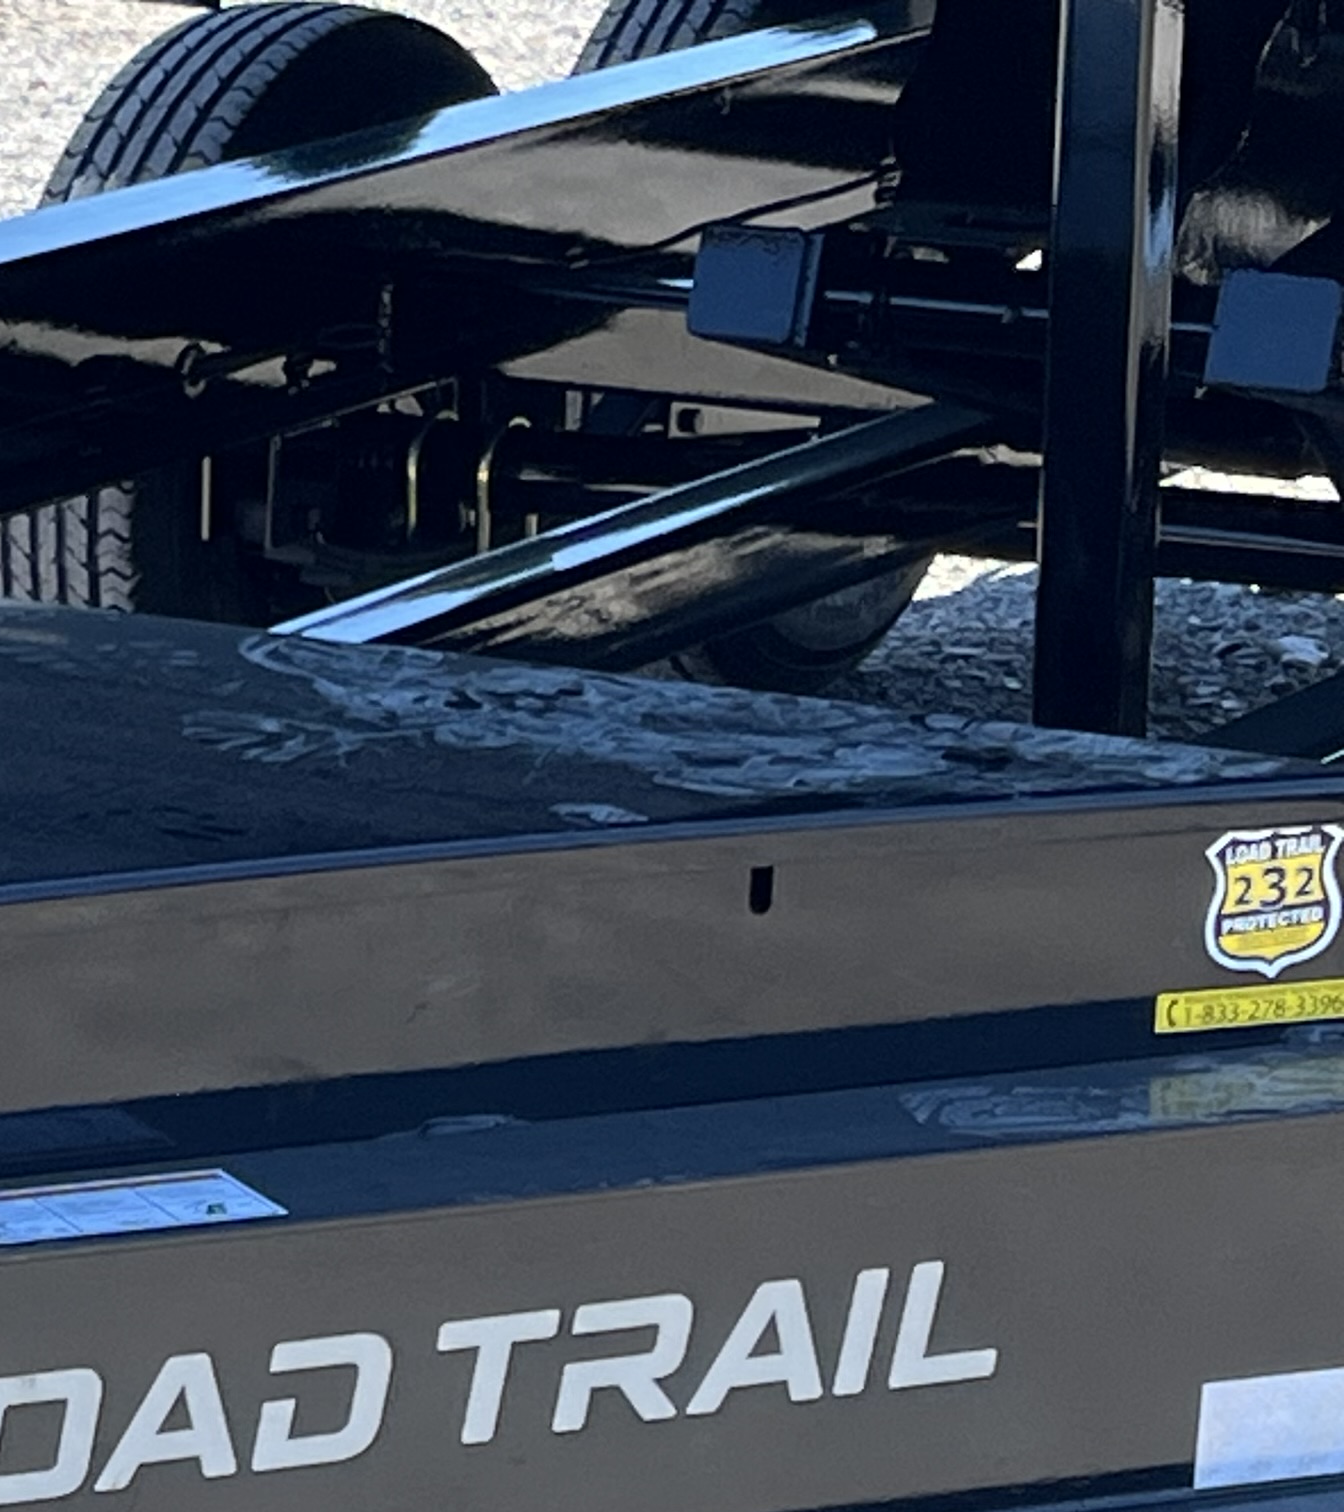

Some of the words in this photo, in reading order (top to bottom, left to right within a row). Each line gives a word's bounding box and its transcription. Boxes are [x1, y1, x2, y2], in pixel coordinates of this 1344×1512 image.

[1224, 840, 1273, 865] LOAD
[1275, 834, 1325, 859] TRAIL
[1233, 865, 1316, 907] 232
[436, 1260, 998, 1445] TRAIL
